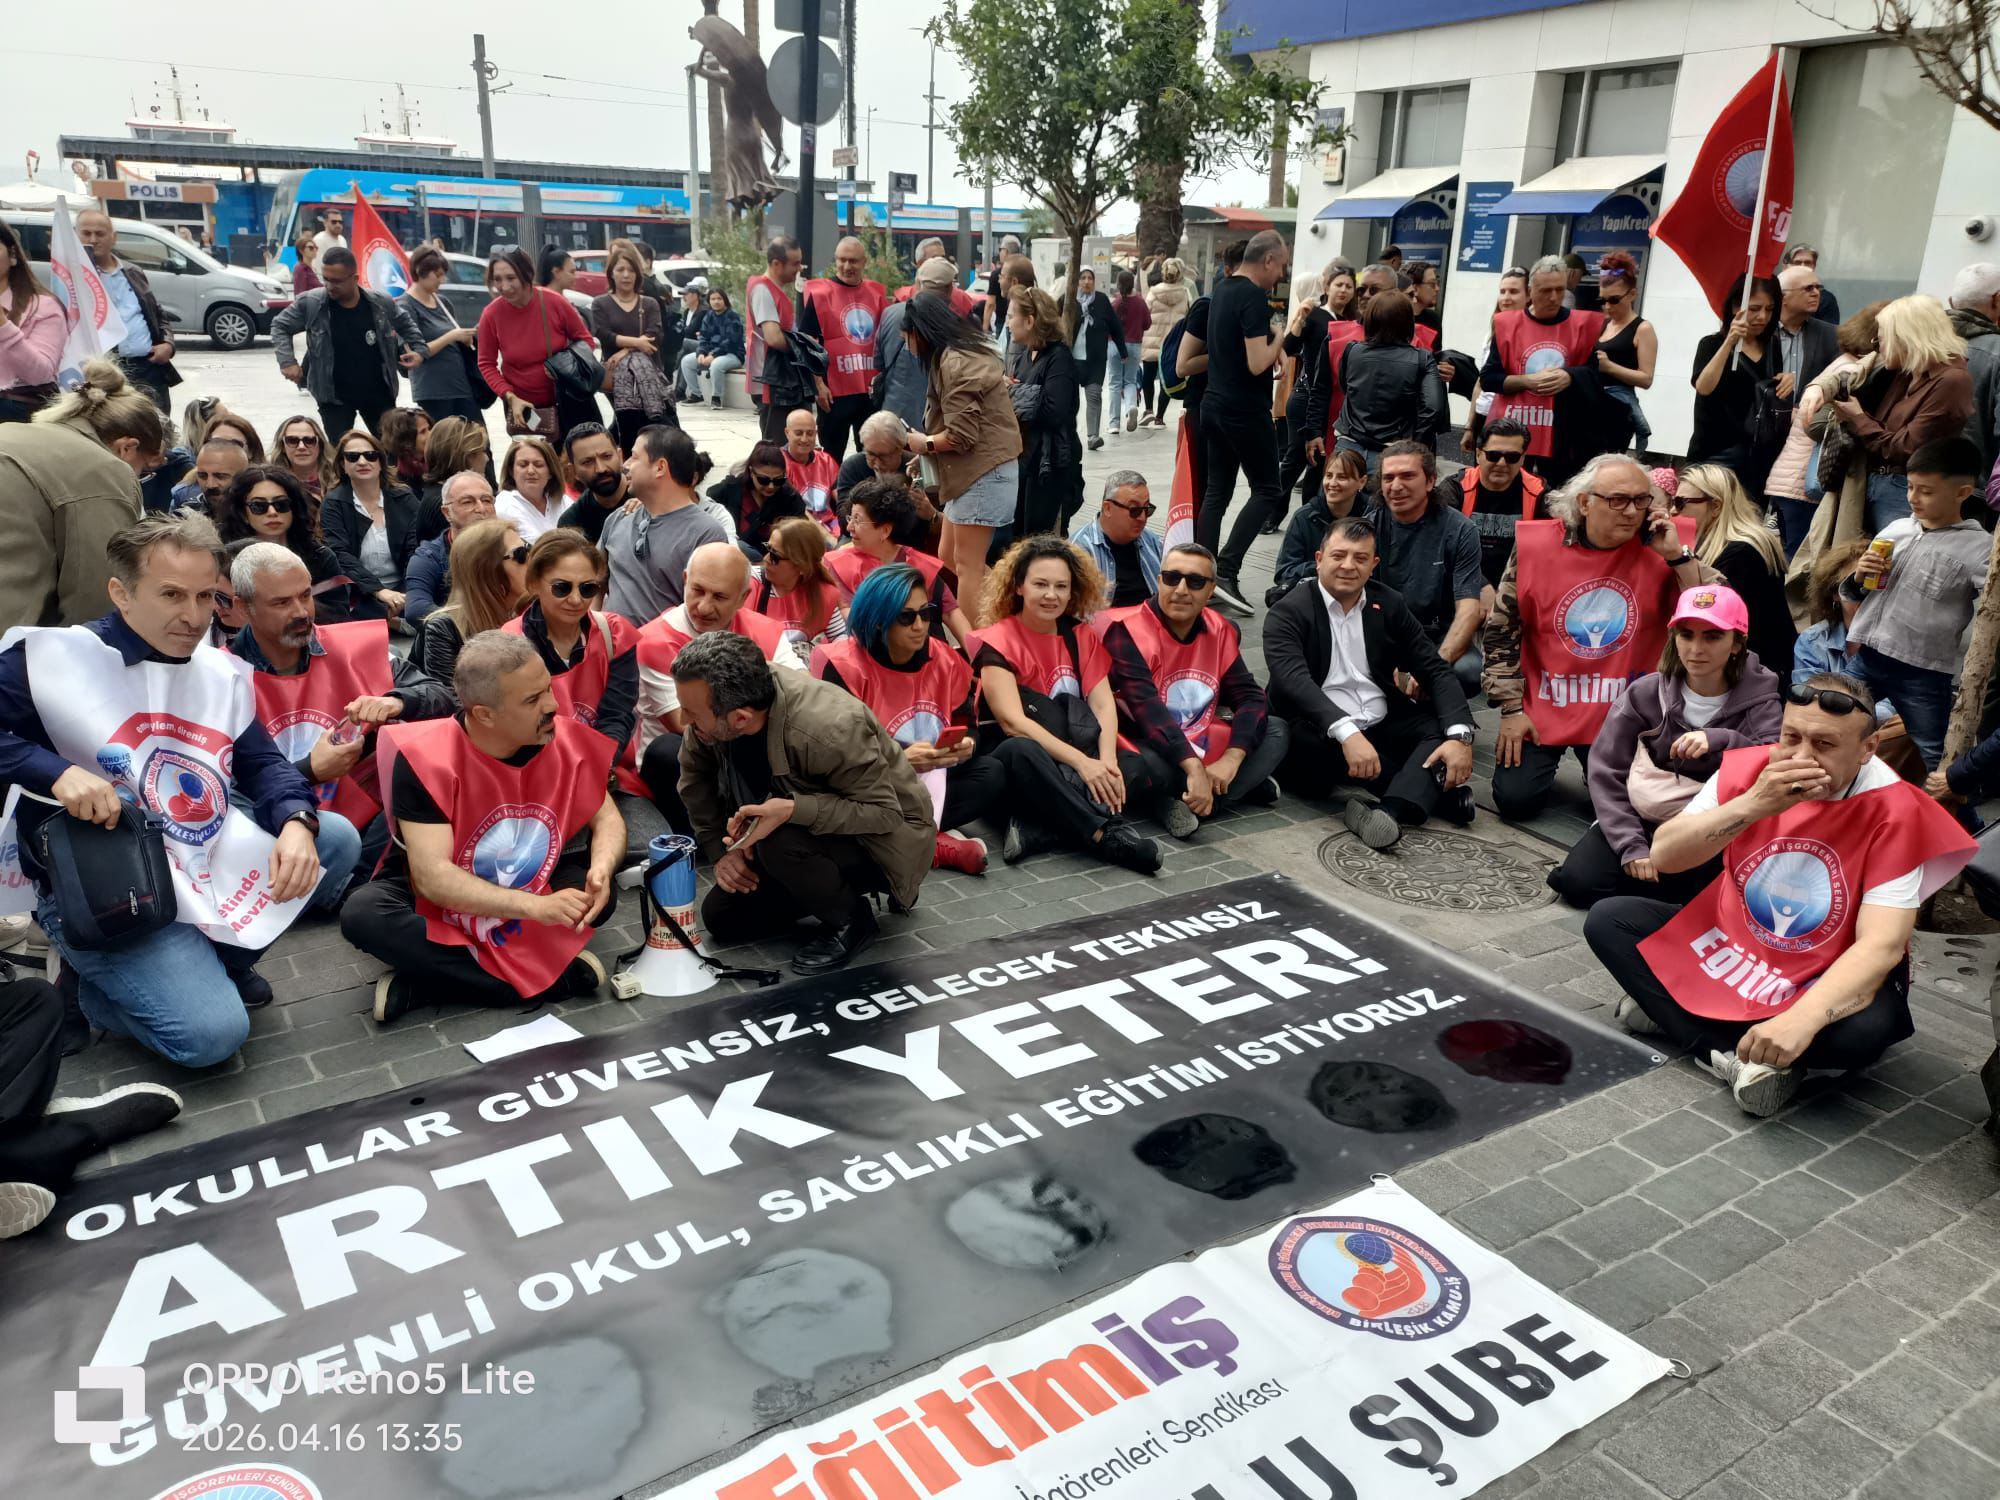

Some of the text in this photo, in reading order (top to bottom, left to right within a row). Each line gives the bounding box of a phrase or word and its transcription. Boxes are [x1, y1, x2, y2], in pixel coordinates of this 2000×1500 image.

[1538, 670, 1627, 708] Eğitim
[1820, 881, 1843, 935] SENDİKASI
[65, 900, 1281, 1241] OKULLAR GÜVENSİZ, GELECEK TEKİNSİZ
[89, 927, 1390, 1368] ARTIK YETER!
[89, 986, 1467, 1467] GÜVENLİ OKUL, SAĞLIKLI EĞİTİM İSTİYORUZ.
[1349, 1317, 1436, 1339] BİRLEŞİK
[1162, 1377, 1290, 1444] Sendikası
[1348, 1312, 1610, 1487] ŞUBE
[265, 1473, 309, 1500] SENDİKA
